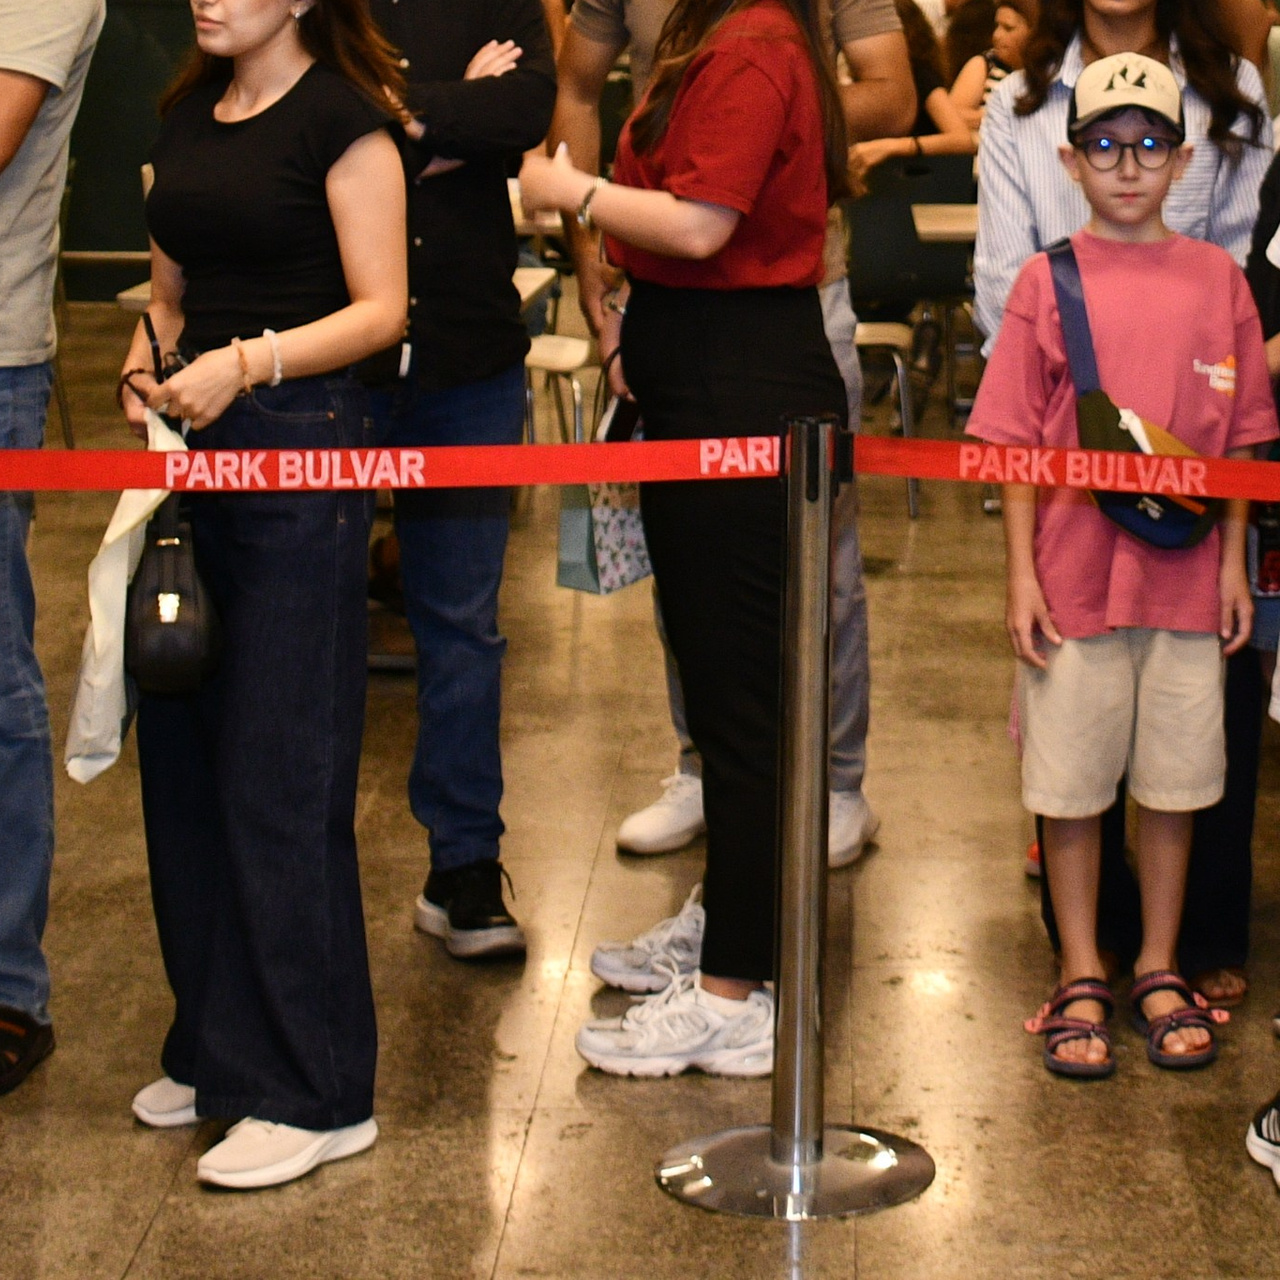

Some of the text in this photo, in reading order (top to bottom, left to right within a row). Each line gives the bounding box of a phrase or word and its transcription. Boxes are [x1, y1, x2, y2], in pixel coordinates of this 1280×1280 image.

[165, 450, 425, 489] PARK BULVAR
[700, 436, 780, 475] PAR
[959, 444, 1208, 495] PARK BULVAR
